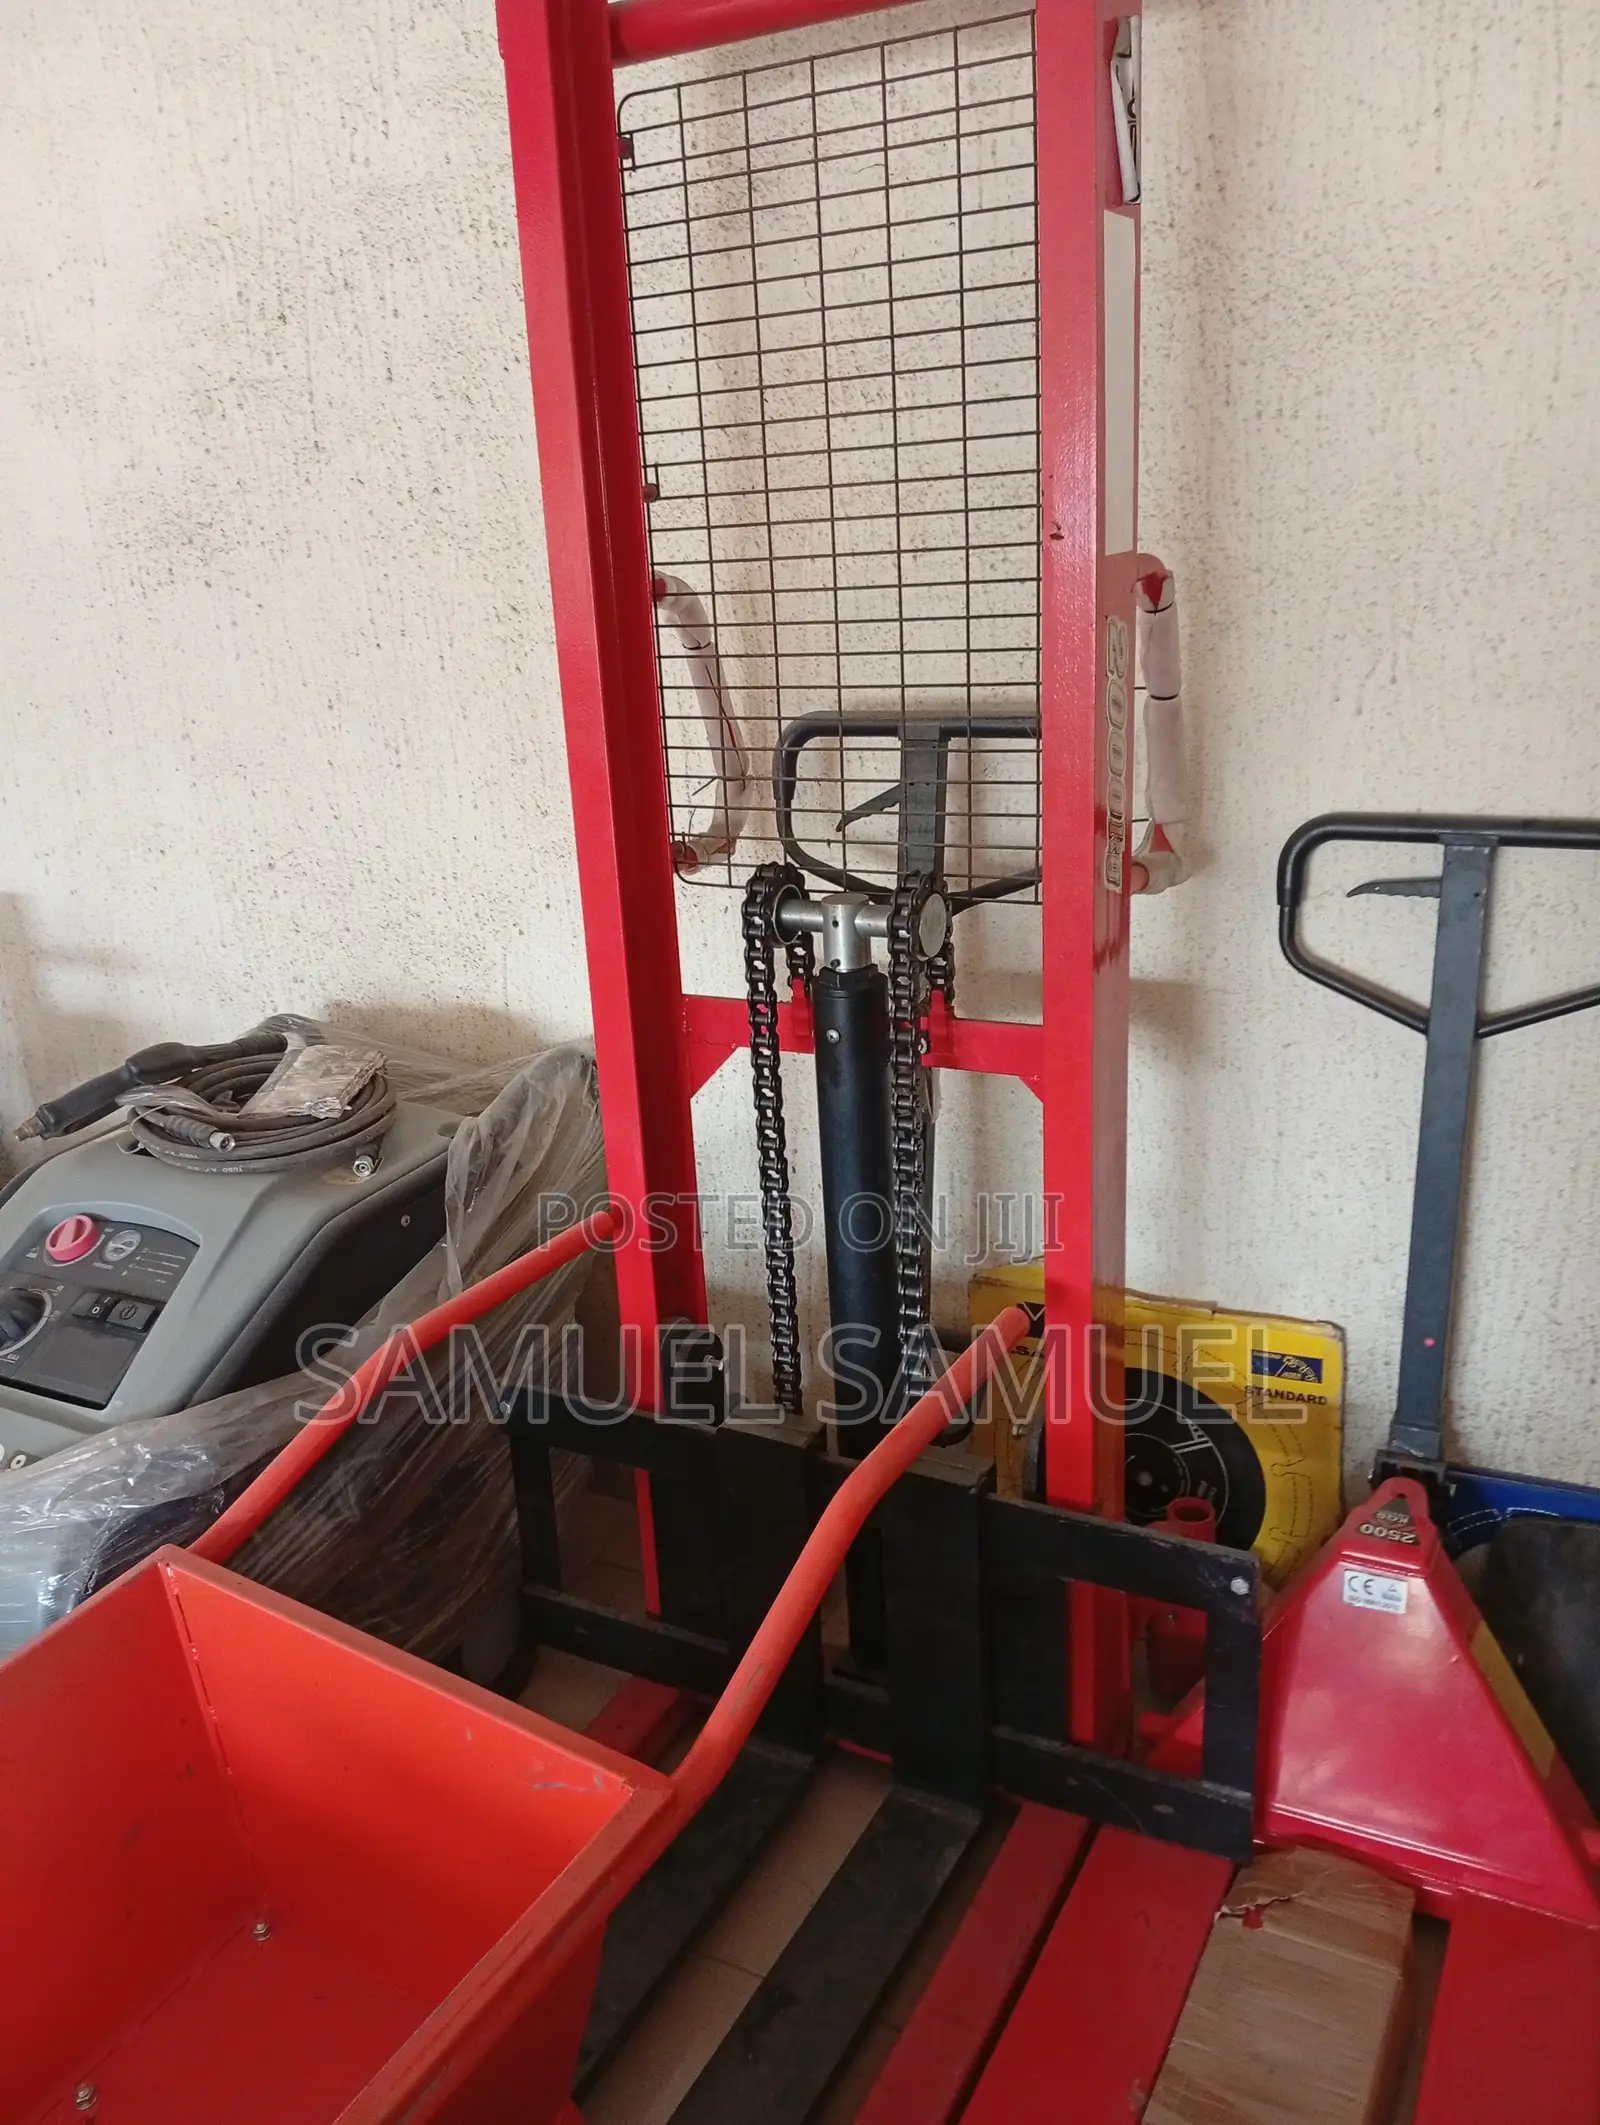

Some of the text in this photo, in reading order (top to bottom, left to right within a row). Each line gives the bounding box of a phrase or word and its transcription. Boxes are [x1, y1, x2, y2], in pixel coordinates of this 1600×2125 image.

[1244, 1385, 1328, 1405] STANDARD
[1359, 1523, 1417, 1544] 2500
[1348, 1575, 1375, 1596] CE
